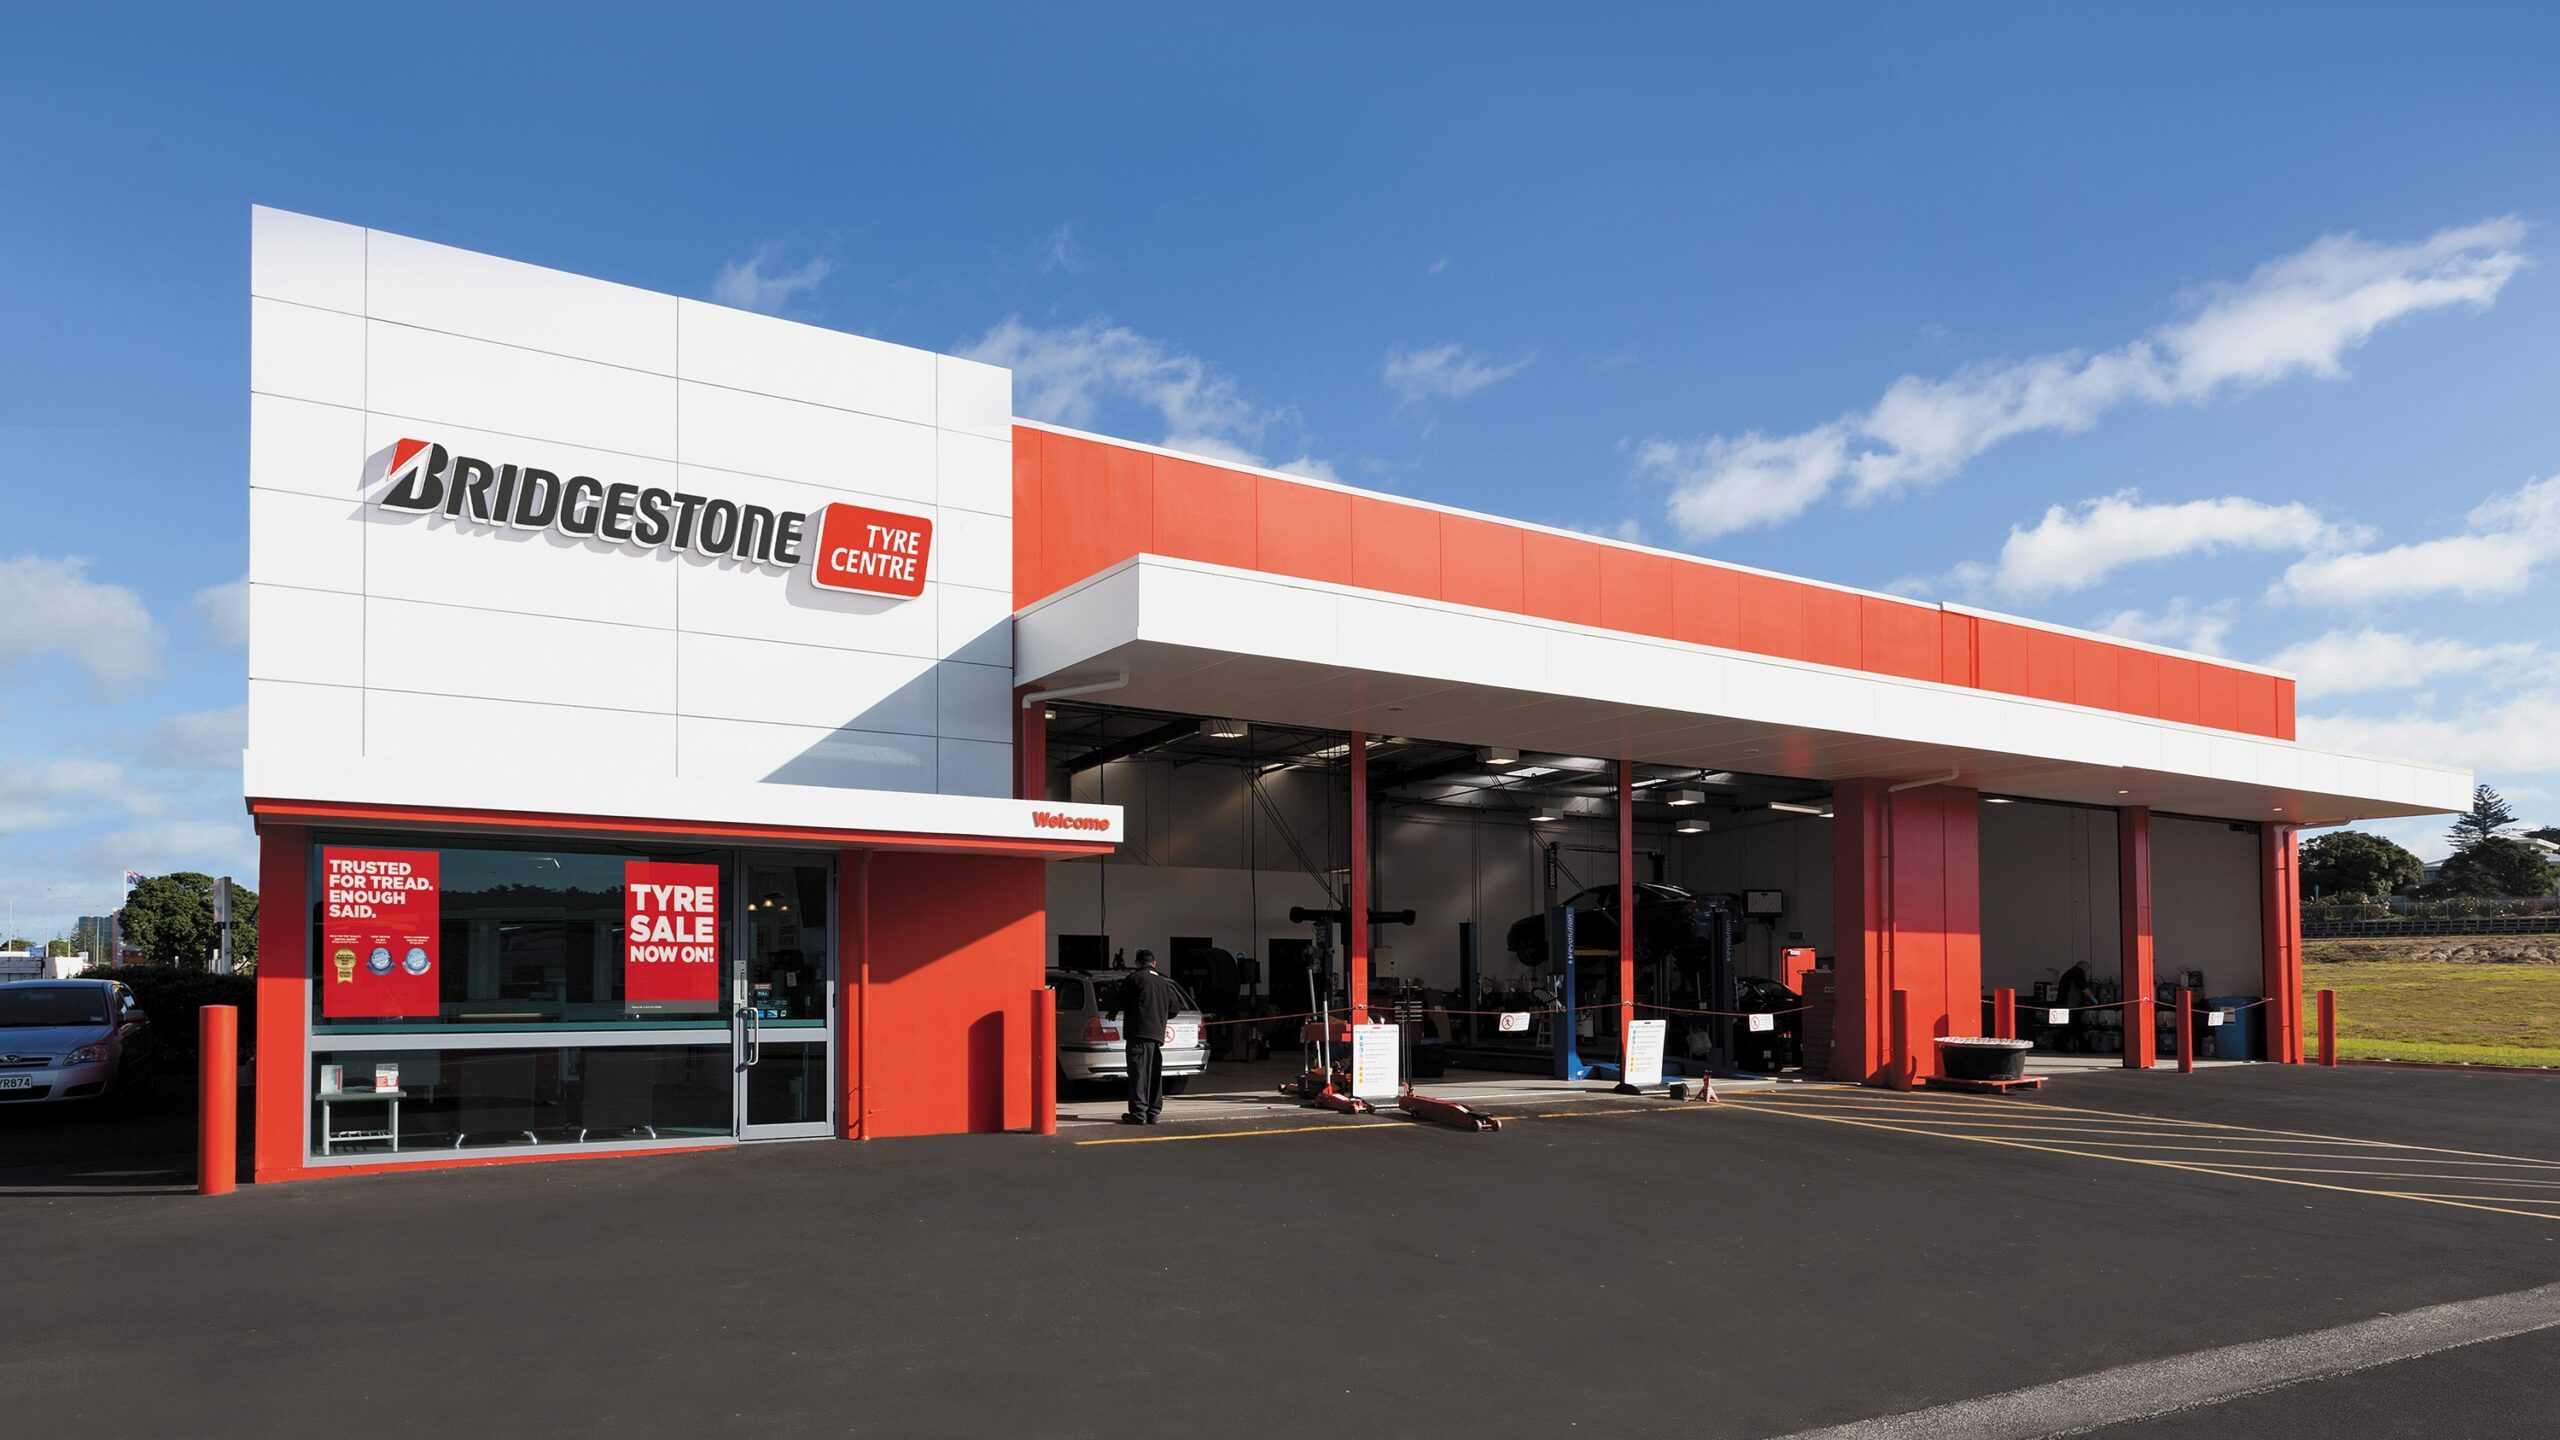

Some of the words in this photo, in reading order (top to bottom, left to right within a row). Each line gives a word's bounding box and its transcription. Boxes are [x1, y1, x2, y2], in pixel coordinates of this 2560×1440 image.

[380, 438, 806, 566] BRIDGESTONE
[866, 524, 921, 554] TYRE
[831, 546, 916, 581] CENTRE
[1032, 811, 1110, 831] Welcome
[329, 859, 411, 876] TRUSTED
[329, 874, 366, 889] FOR
[370, 876, 433, 891] TREAD.
[329, 889, 406, 905] ENOUGH
[630, 883, 714, 913] TYRE
[329, 904, 377, 919] SAID.
[629, 914, 714, 943] SALE
[630, 945, 678, 963] NOW
[681, 946, 714, 963] ON!
